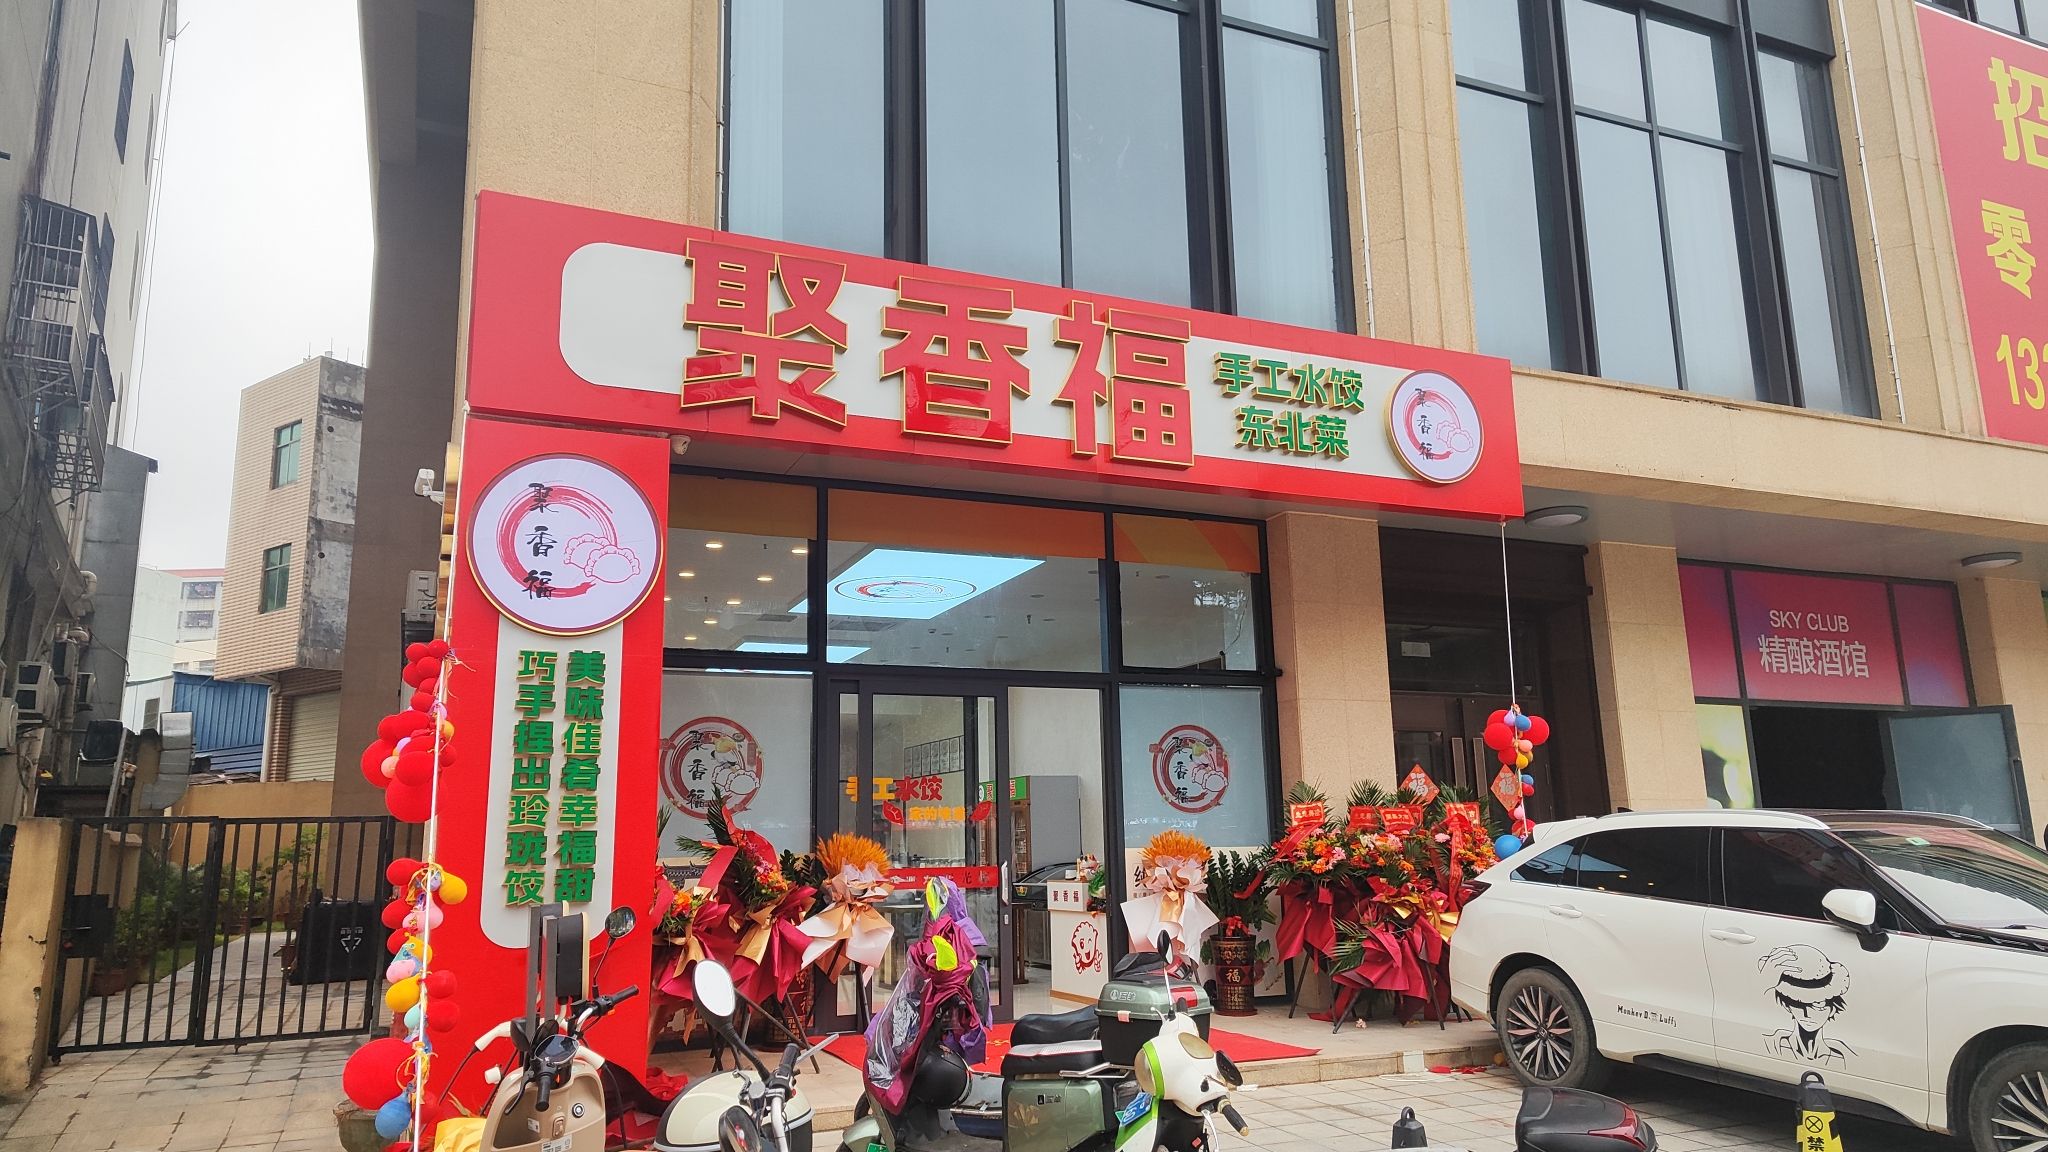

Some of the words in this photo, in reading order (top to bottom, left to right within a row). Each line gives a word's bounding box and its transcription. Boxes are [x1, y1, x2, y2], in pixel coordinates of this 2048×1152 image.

[1987, 56, 2048, 170] 招
[1981, 199, 2037, 300] 零
[681, 238, 1194, 468] 聚香福
[1214, 352, 1364, 412] 手工水饺
[1996, 334, 2048, 410] 13
[1236, 406, 1350, 459] 东北菜
[1415, 388, 1433, 460] 聚香福
[522, 482, 558, 600] 聚香福
[1757, 634, 1870, 679] 精酿酒馆
[1769, 610, 1802, 630] SKY
[1807, 613, 1850, 634] CLUB
[502, 650, 558, 905] 巧手捏出玲珑饺
[553, 649, 606, 903] 美味佳肴幸福甜
[686, 730, 709, 809] 聚香福
[1172, 736, 1189, 804] 聚香福
[1409, 773, 1428, 796] 福
[1225, 968, 1240, 982] 福
[1617, 1004, 1643, 1018] Monkey
[1660, 1013, 1677, 1027] Luffy
[1807, 1135, 1825, 1152] 禁
